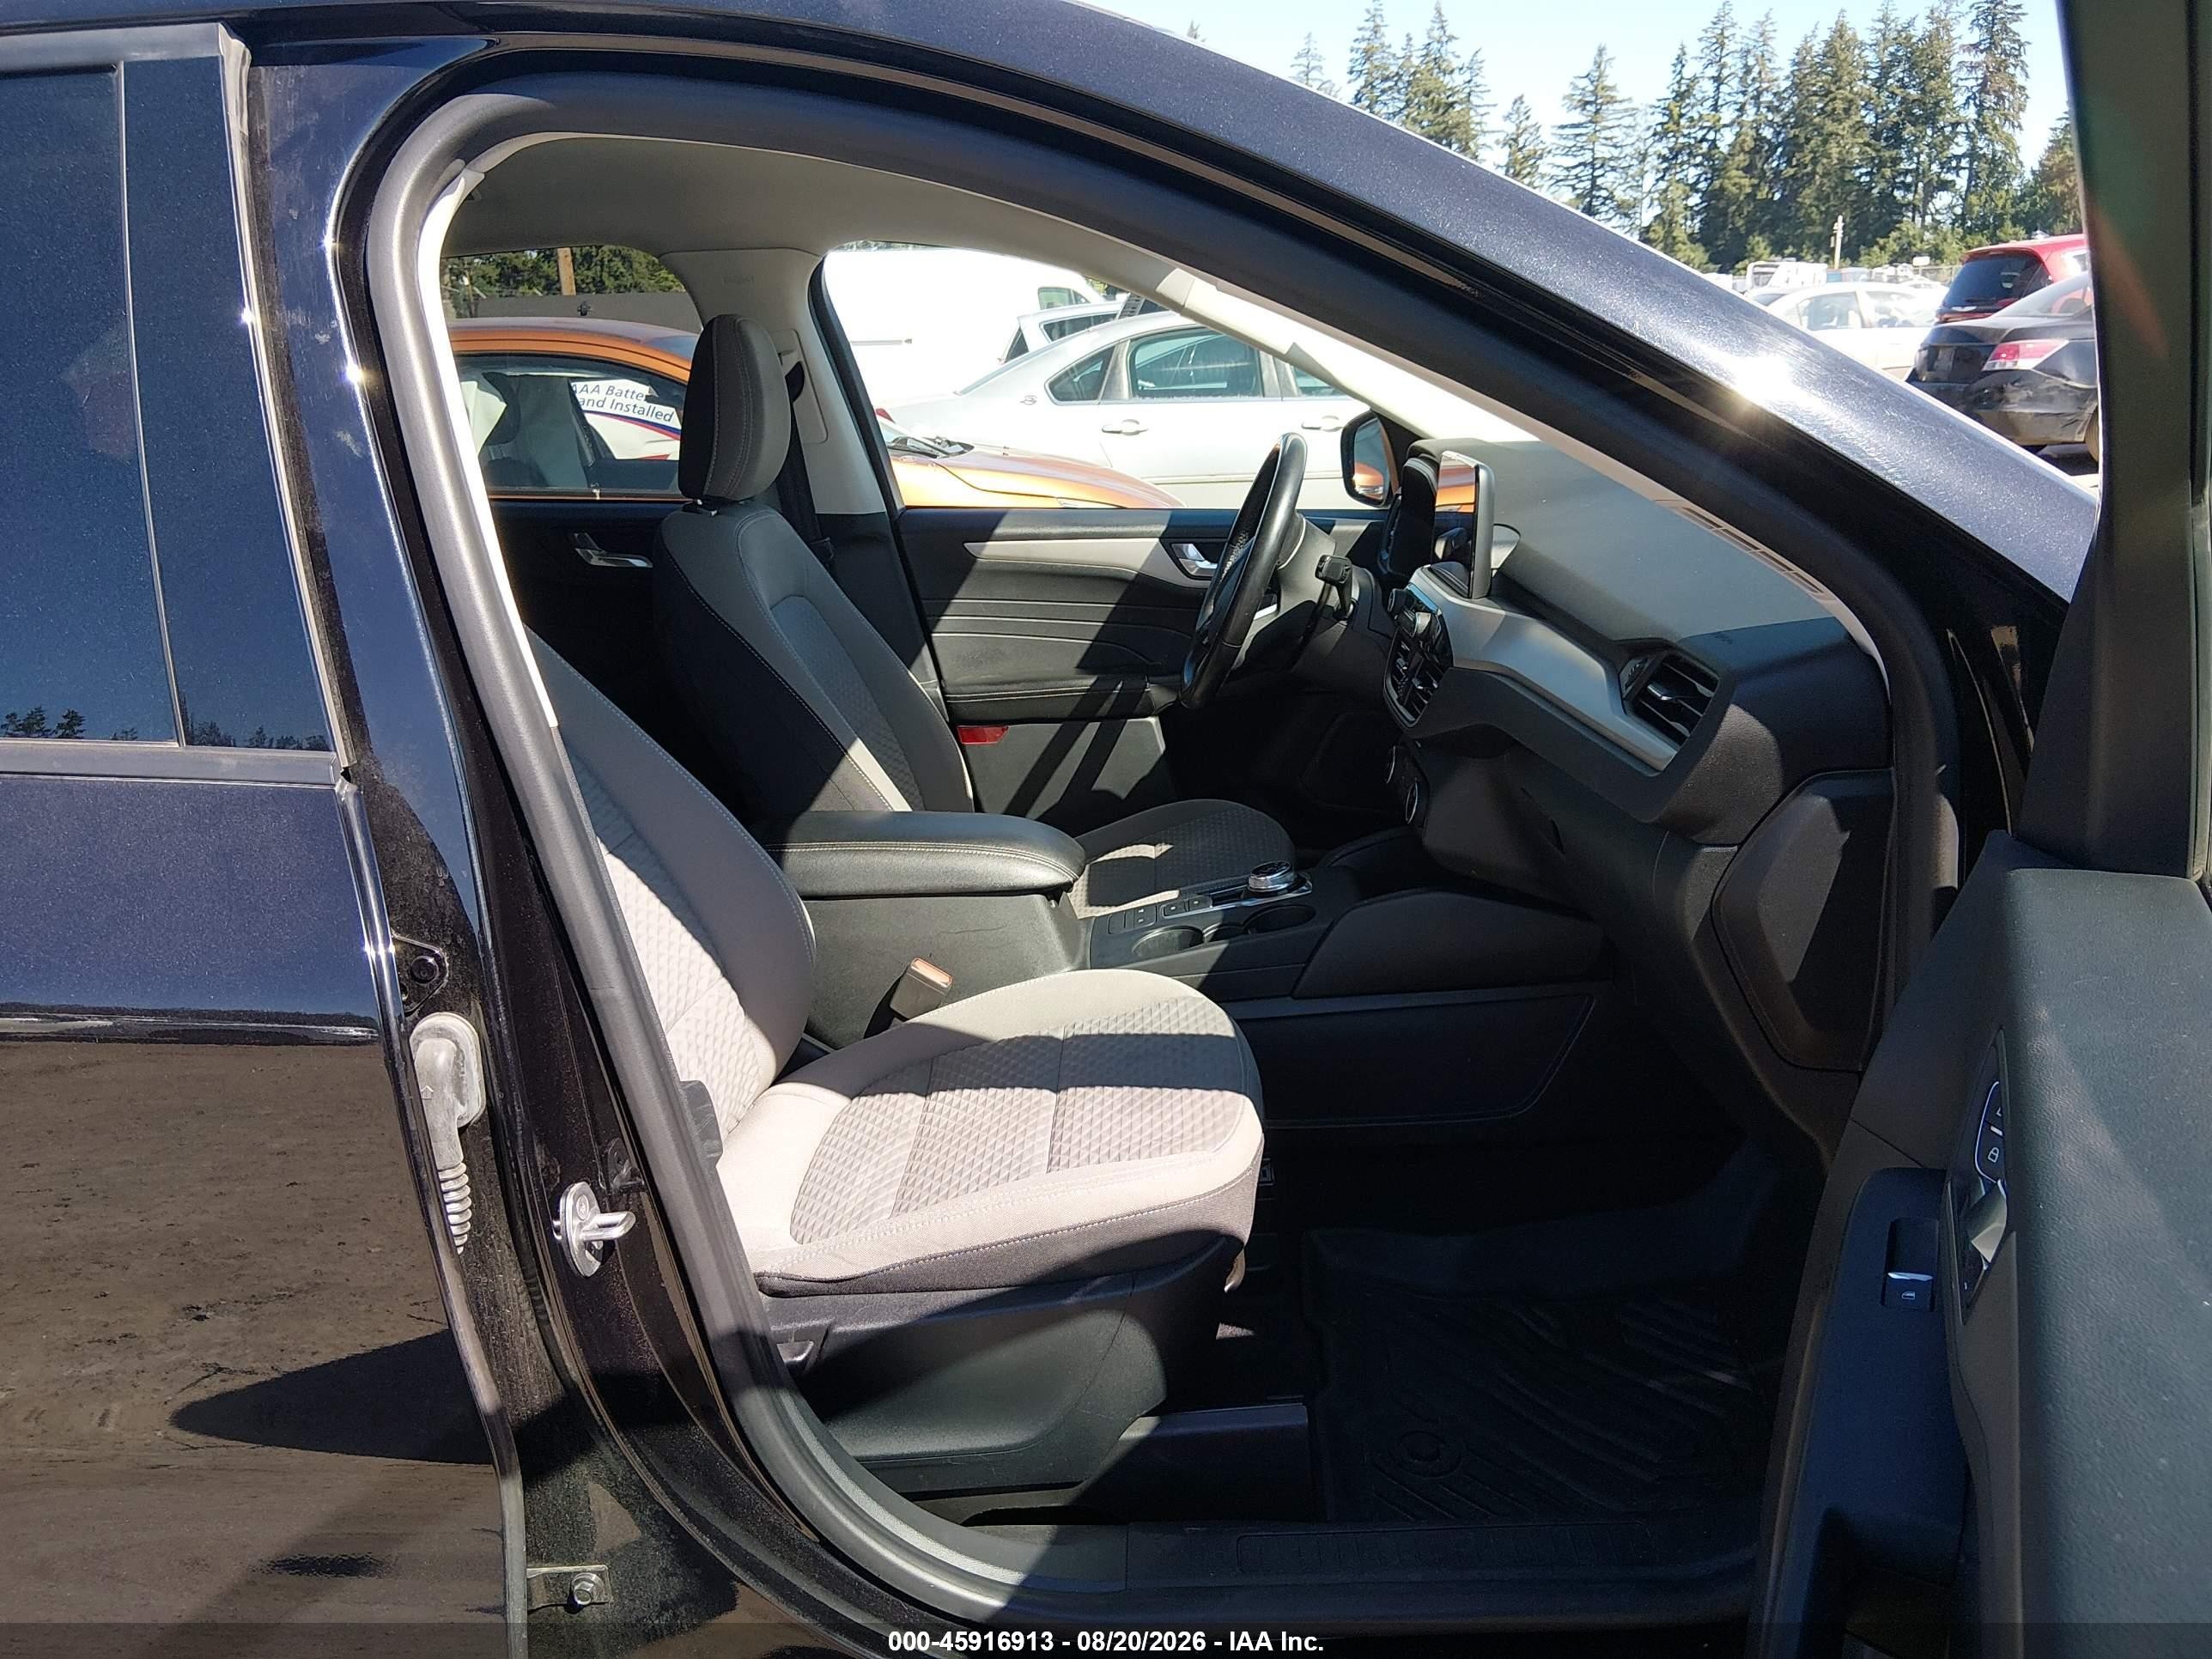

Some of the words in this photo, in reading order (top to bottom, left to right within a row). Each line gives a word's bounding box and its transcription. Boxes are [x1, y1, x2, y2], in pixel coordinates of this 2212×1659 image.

[605, 385, 647, 402] Batte
[579, 397, 606, 409] and
[610, 398, 674, 422] Installed
